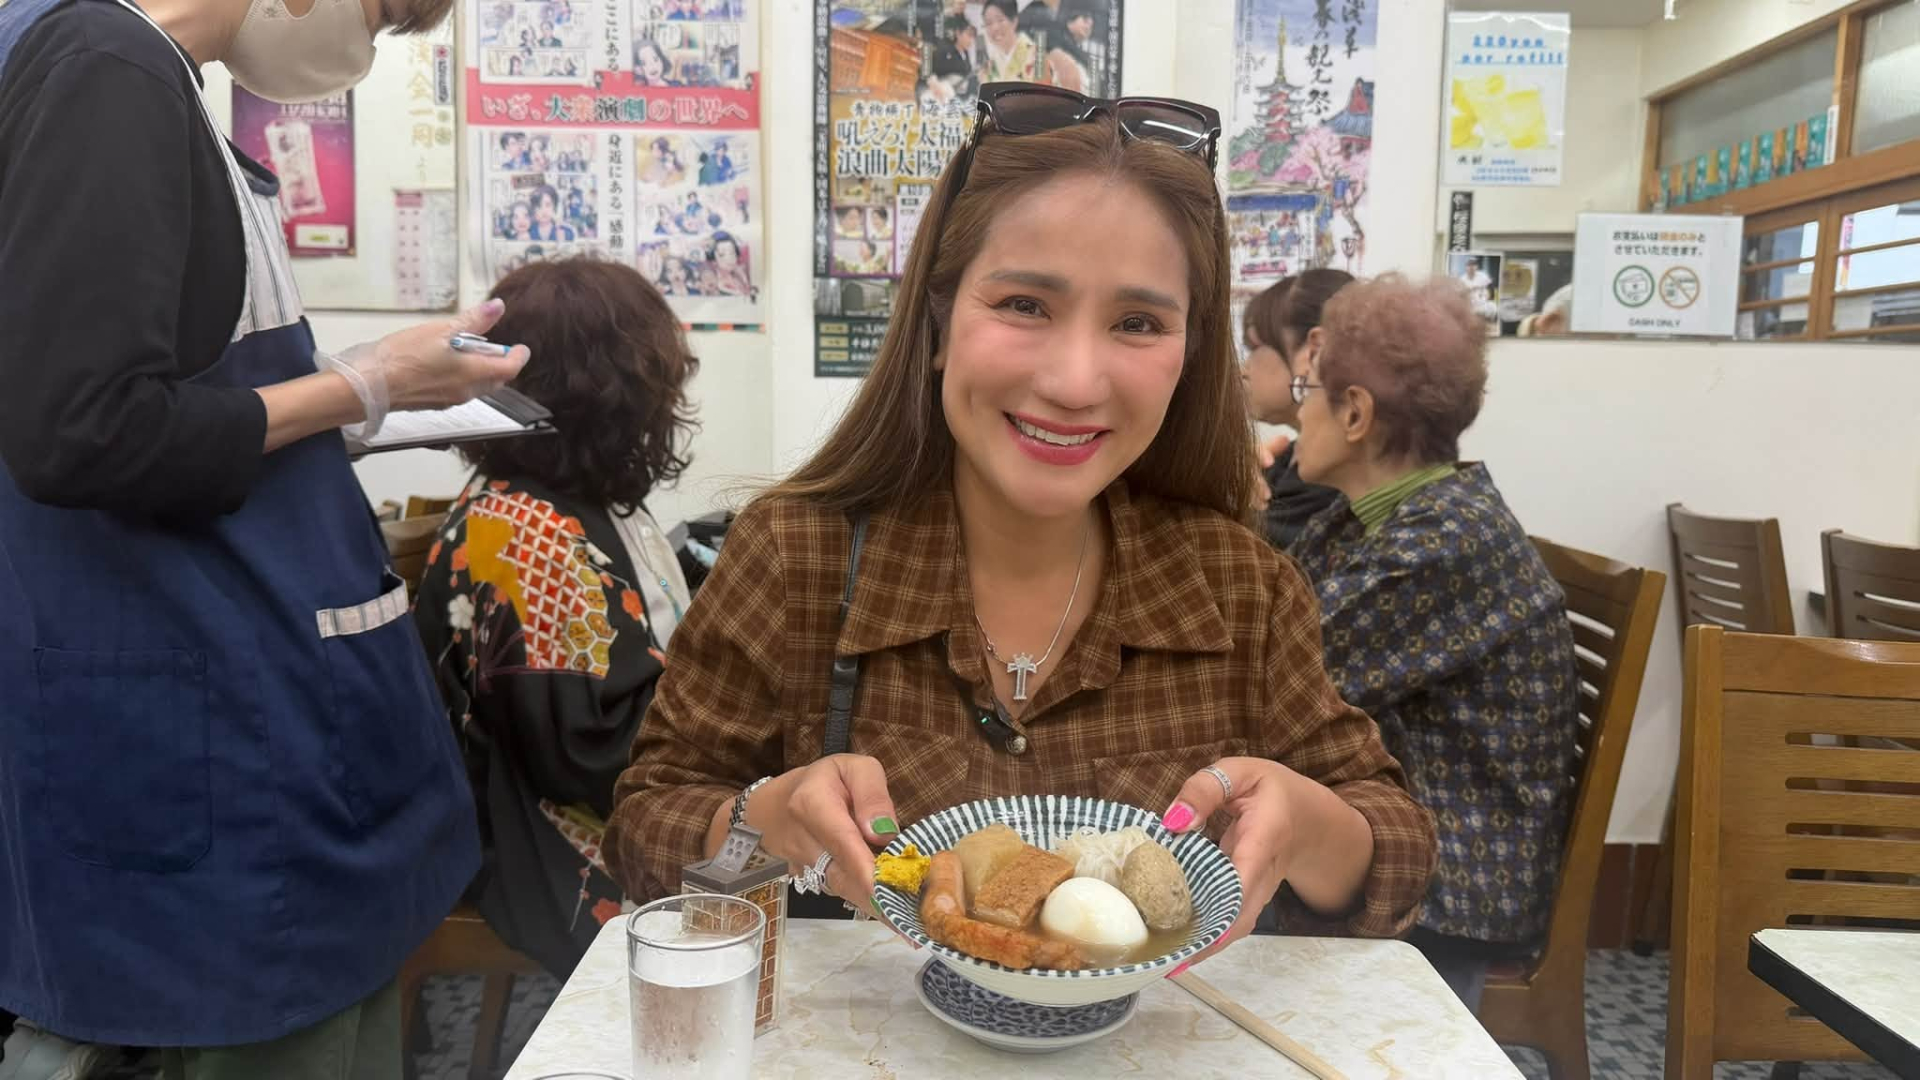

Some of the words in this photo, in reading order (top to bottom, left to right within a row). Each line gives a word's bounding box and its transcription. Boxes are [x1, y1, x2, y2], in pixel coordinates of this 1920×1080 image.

[476, 93, 749, 124] いざ、大衆演劇の世界へ
[837, 148, 950, 177] 浪曲太陽
[1628, 317, 1655, 327] CASH
[1656, 318, 1681, 328] ONLY
